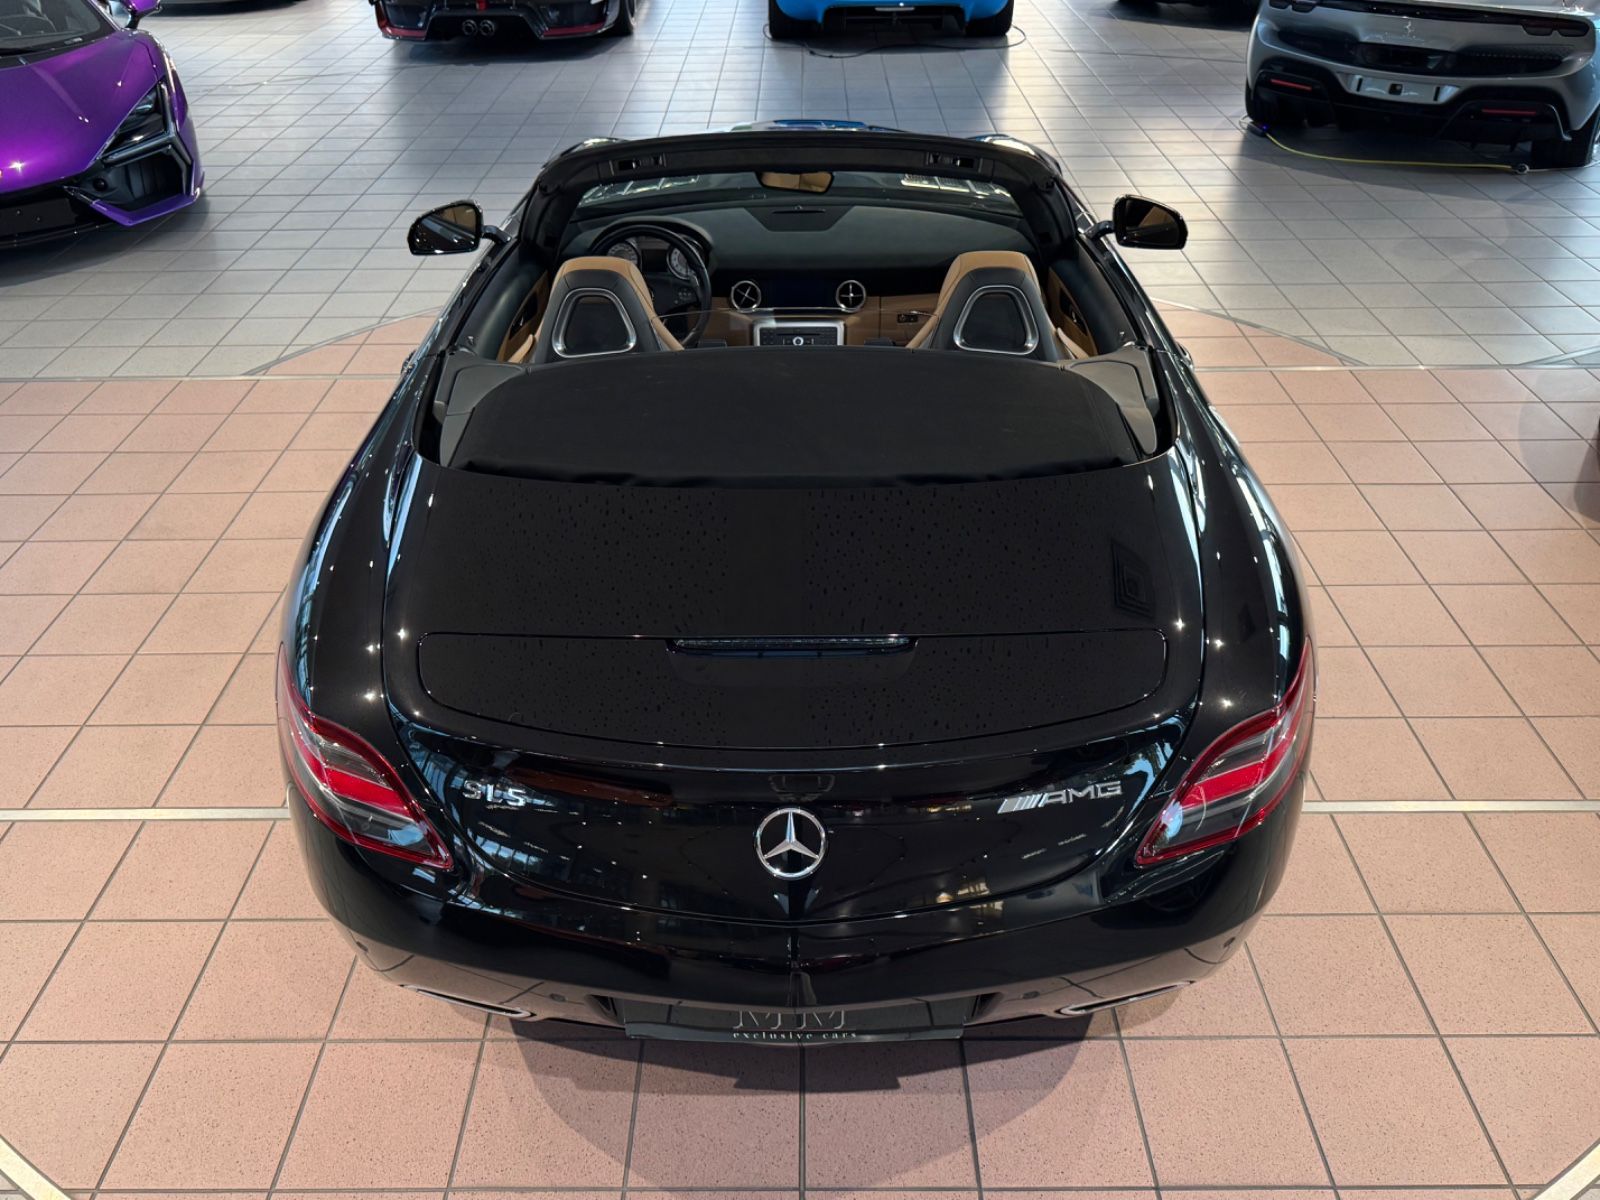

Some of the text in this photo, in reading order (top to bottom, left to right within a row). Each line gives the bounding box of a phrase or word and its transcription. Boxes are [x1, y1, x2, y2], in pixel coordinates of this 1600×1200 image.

[462, 780, 526, 806] SLS
[1039, 780, 1122, 806] AMG
[733, 1031, 857, 1040] exclusive cars
